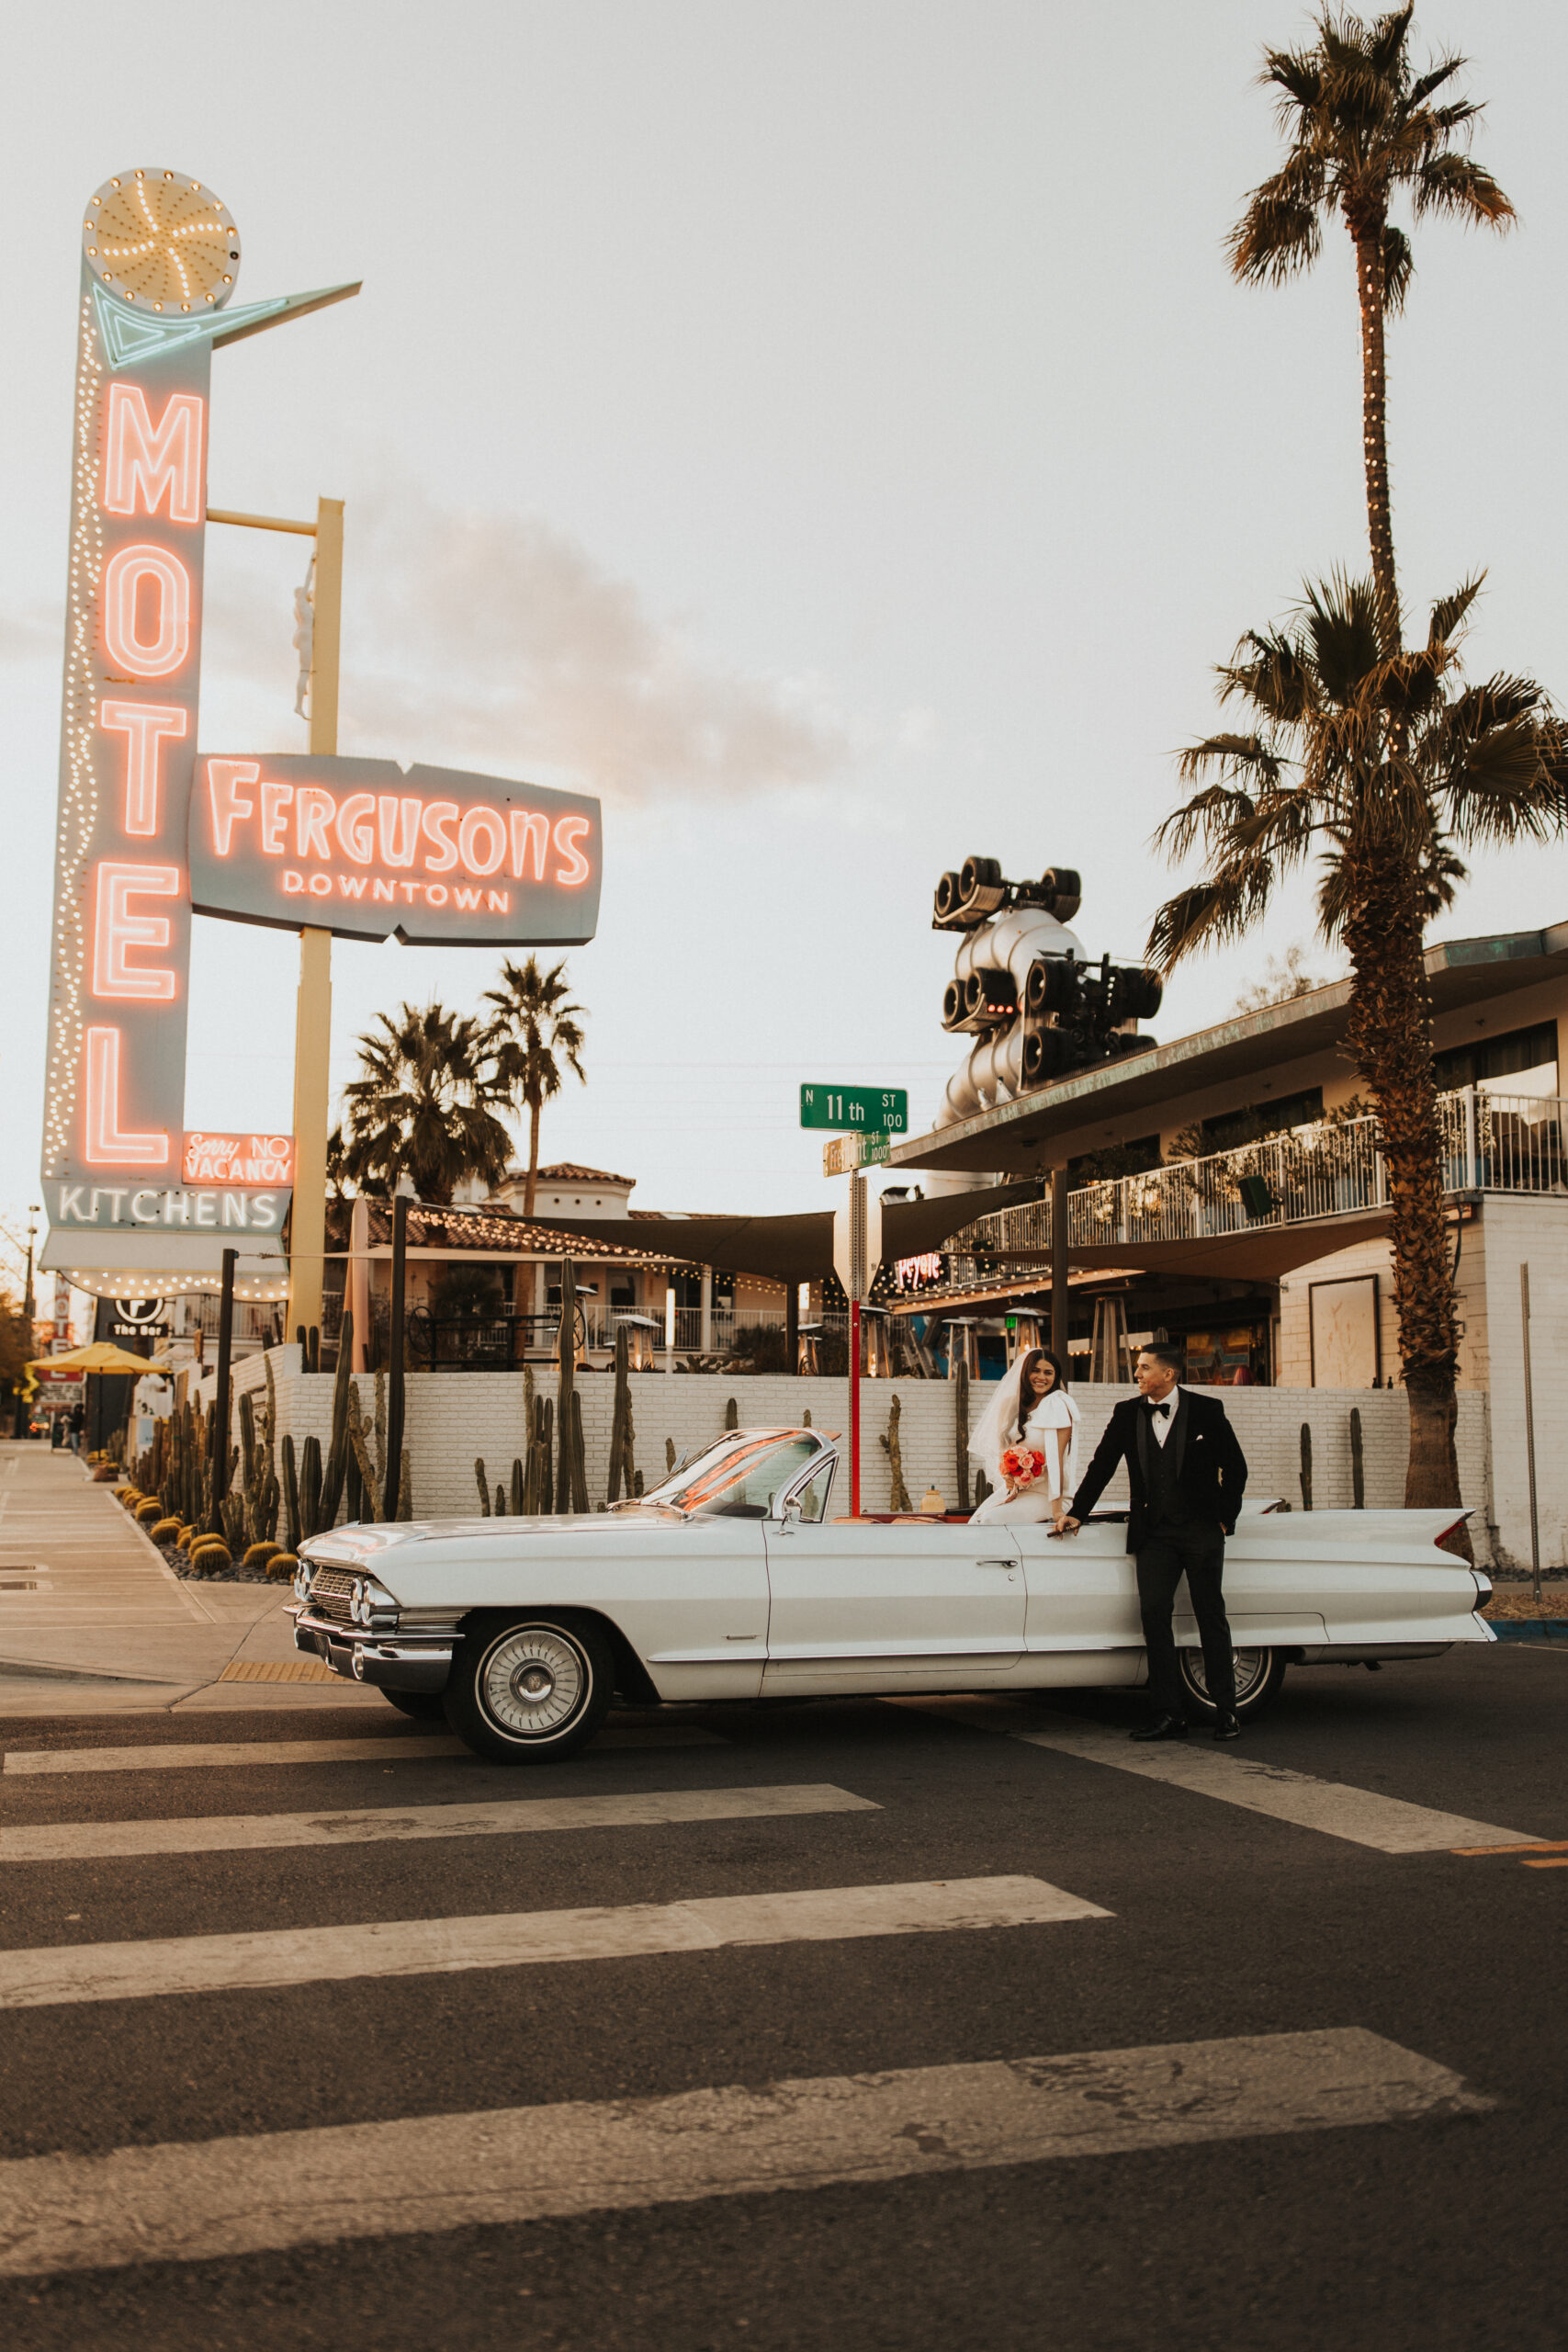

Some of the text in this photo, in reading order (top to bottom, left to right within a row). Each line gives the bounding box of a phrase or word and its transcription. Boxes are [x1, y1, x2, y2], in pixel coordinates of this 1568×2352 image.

[85, 382, 203, 1163] MOTEL
[283, 869, 510, 913] DOWNTOWN
[806, 1089, 814, 1103] N
[882, 1093, 897, 1108] ST
[884, 1114, 903, 1127] 100
[188, 1134, 290, 1161] Sorry NO
[871, 1130, 879, 1145] ST
[872, 1145, 887, 1161] 1000
[186, 1156, 291, 1182] VACANCY
[59, 1185, 277, 1228] KITCHENS
